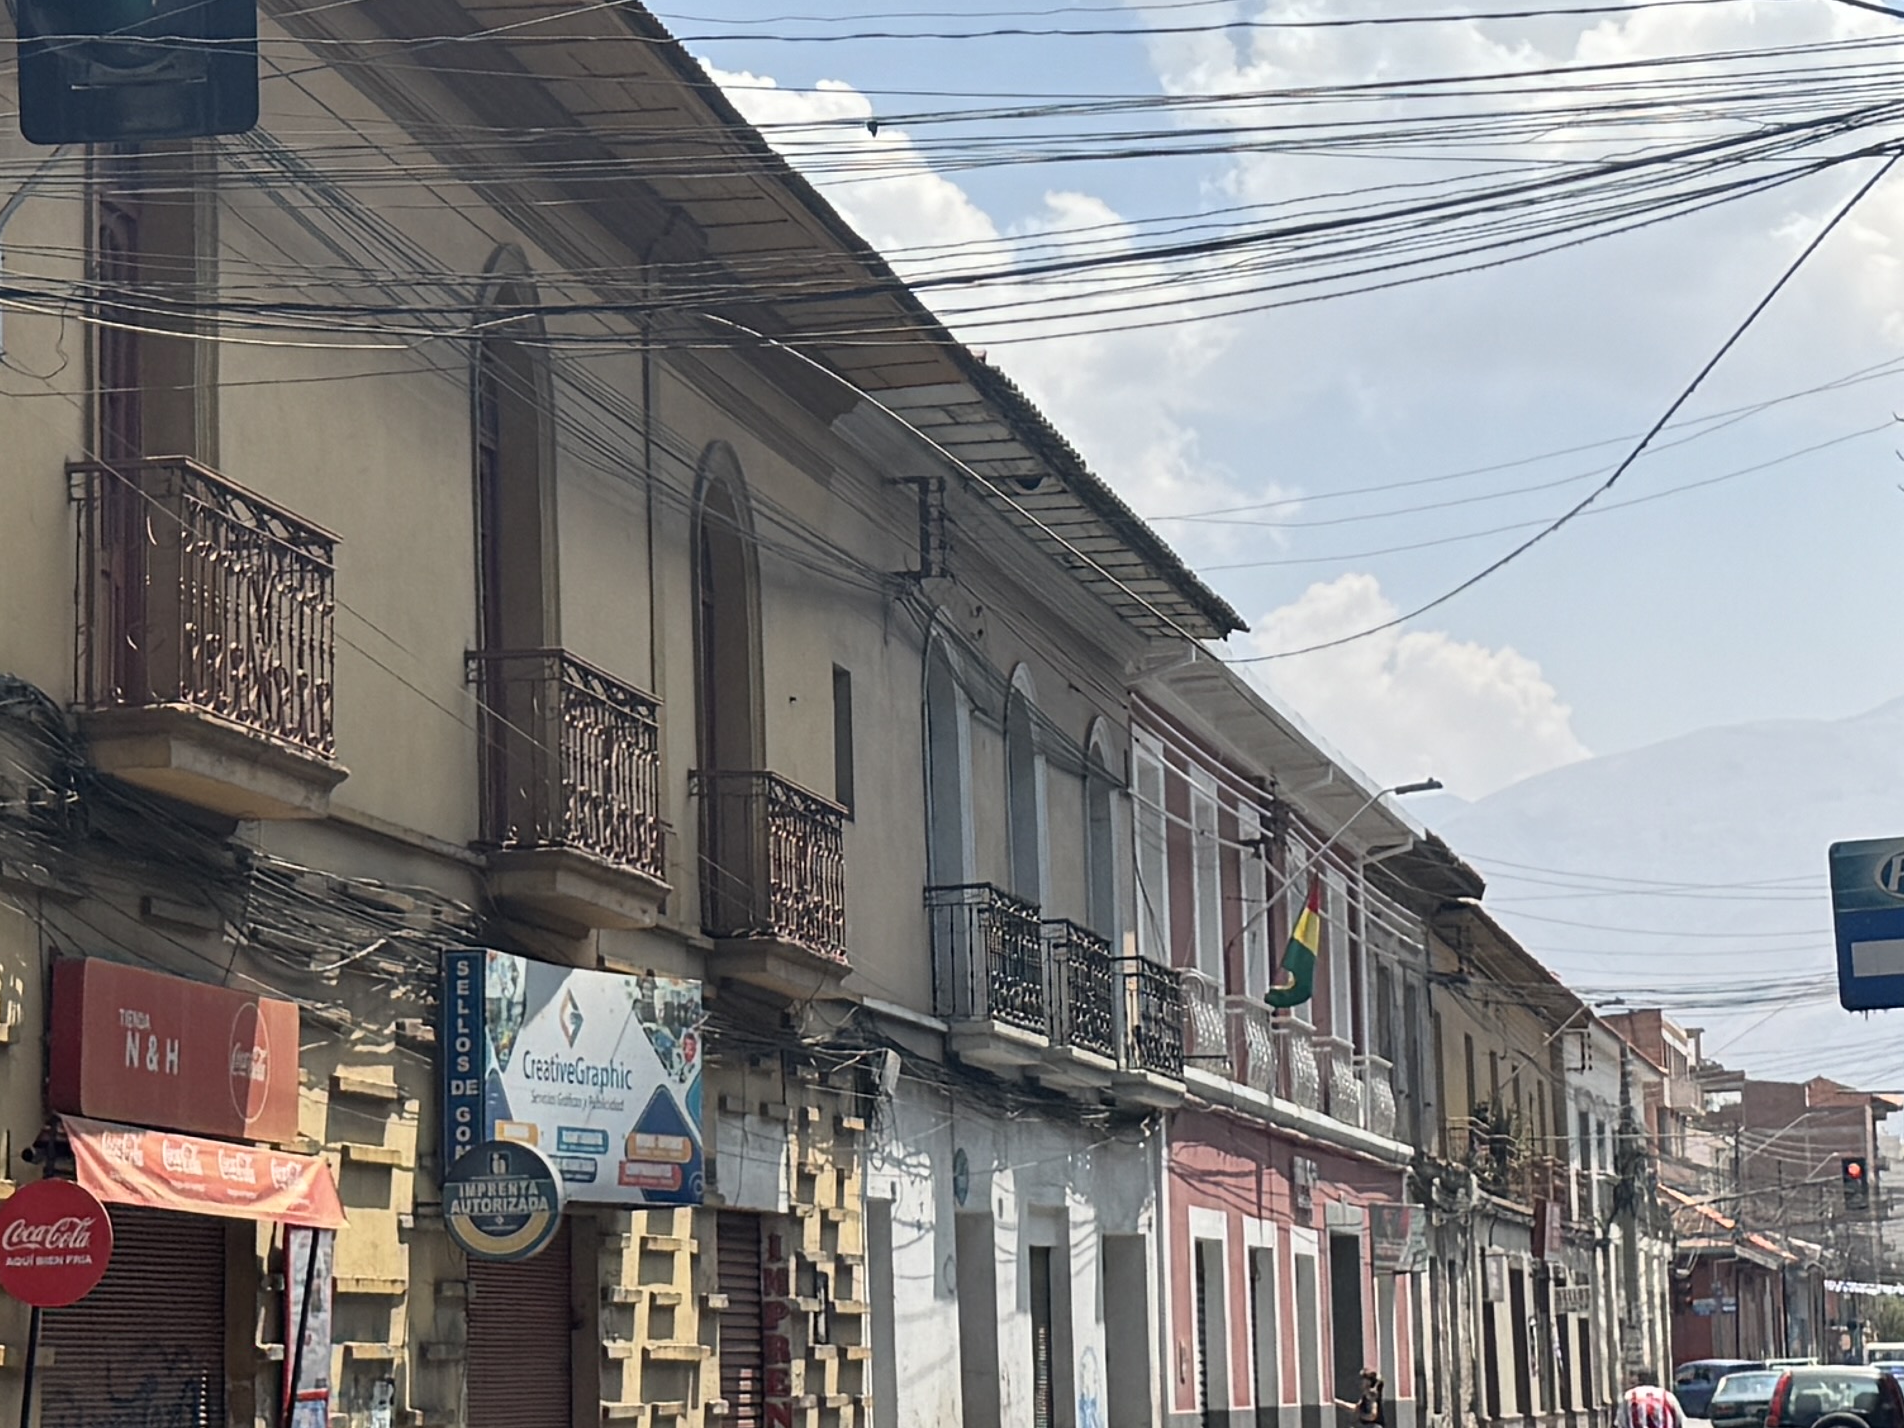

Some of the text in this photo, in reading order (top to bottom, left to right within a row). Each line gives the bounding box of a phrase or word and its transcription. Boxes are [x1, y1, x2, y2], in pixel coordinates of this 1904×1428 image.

[125, 1030, 179, 1075] N & H
[450, 1079, 479, 1096] DE
[523, 1050, 633, 1094] CreativeGraphic
[450, 1196, 550, 1215] AUTORIZADA
